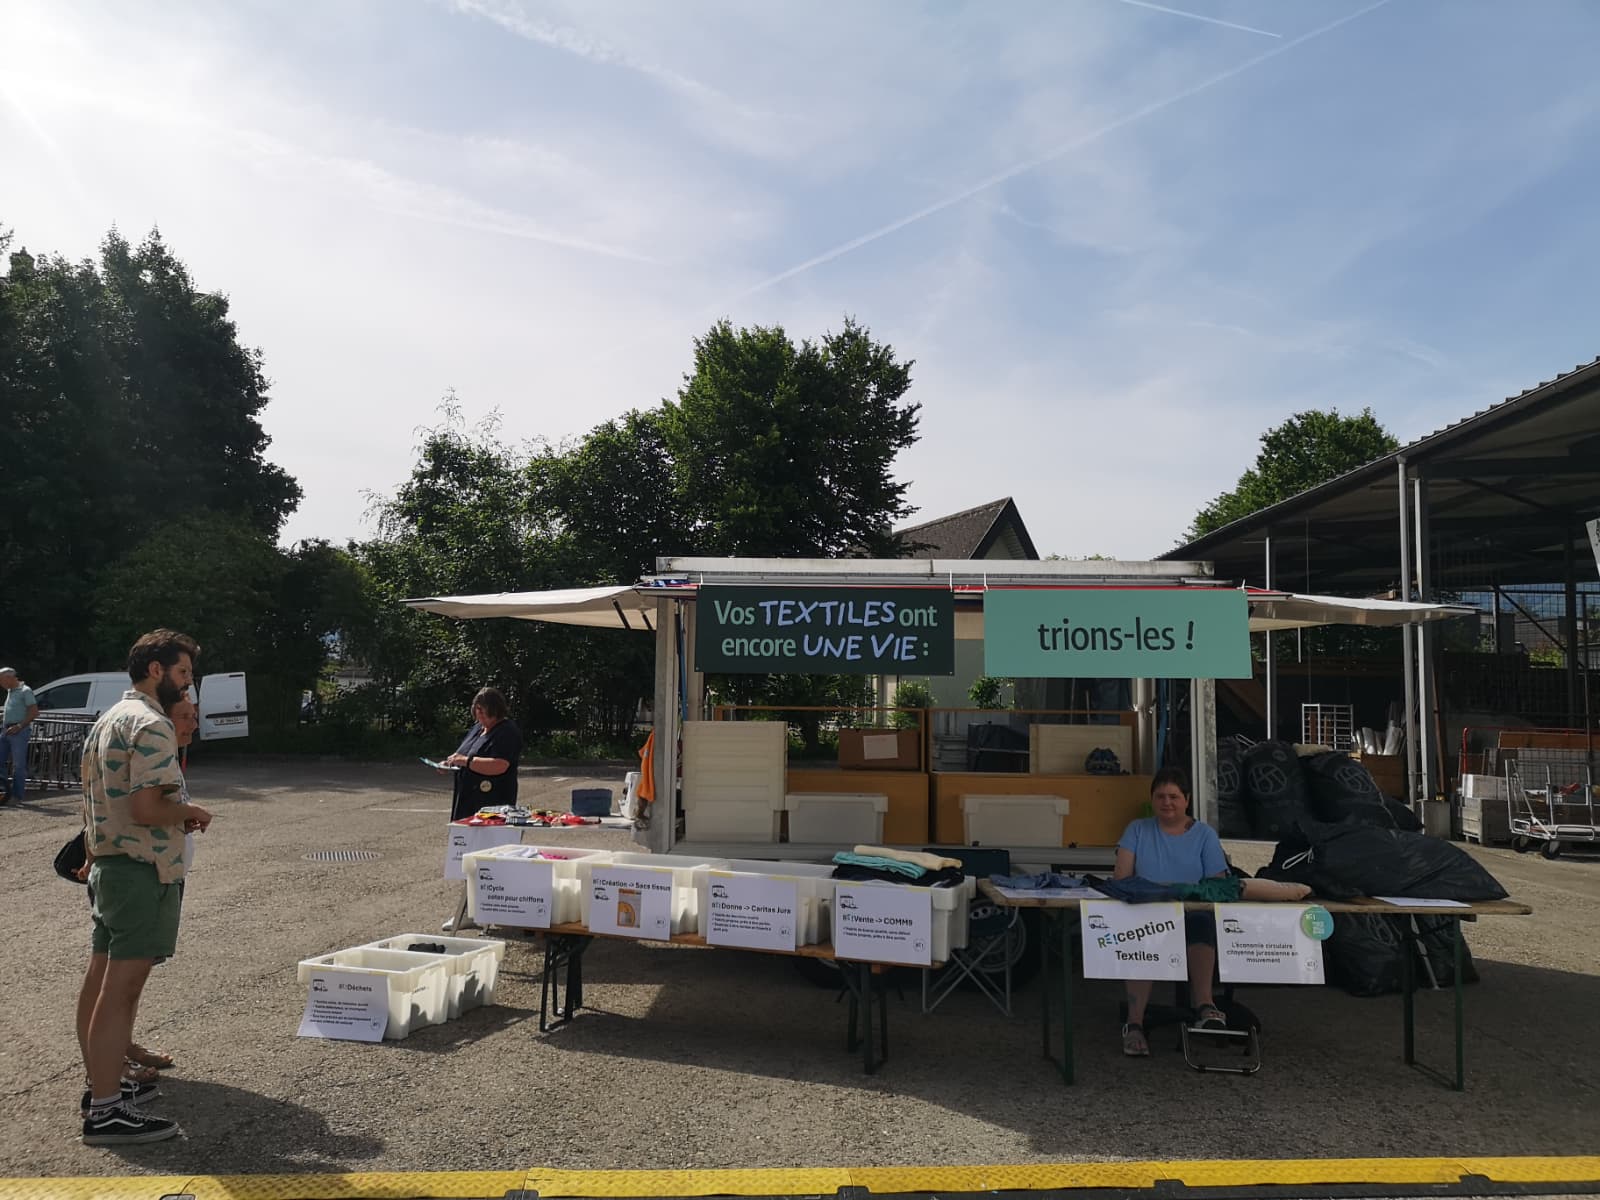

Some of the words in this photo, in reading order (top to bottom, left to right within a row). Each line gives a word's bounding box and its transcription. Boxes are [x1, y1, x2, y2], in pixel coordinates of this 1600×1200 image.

[714, 600, 755, 625] Vos
[758, 600, 896, 628] TEXTILES
[899, 606, 938, 627] ont
[1037, 616, 1175, 651] trions-les
[721, 637, 797, 657] encore
[802, 634, 863, 660] UNE
[518, 895, 544, 904] chiffons
[751, 904, 775, 914] Caritas
[776, 906, 792, 915] Jura
[1115, 950, 1160, 962] Textiles
